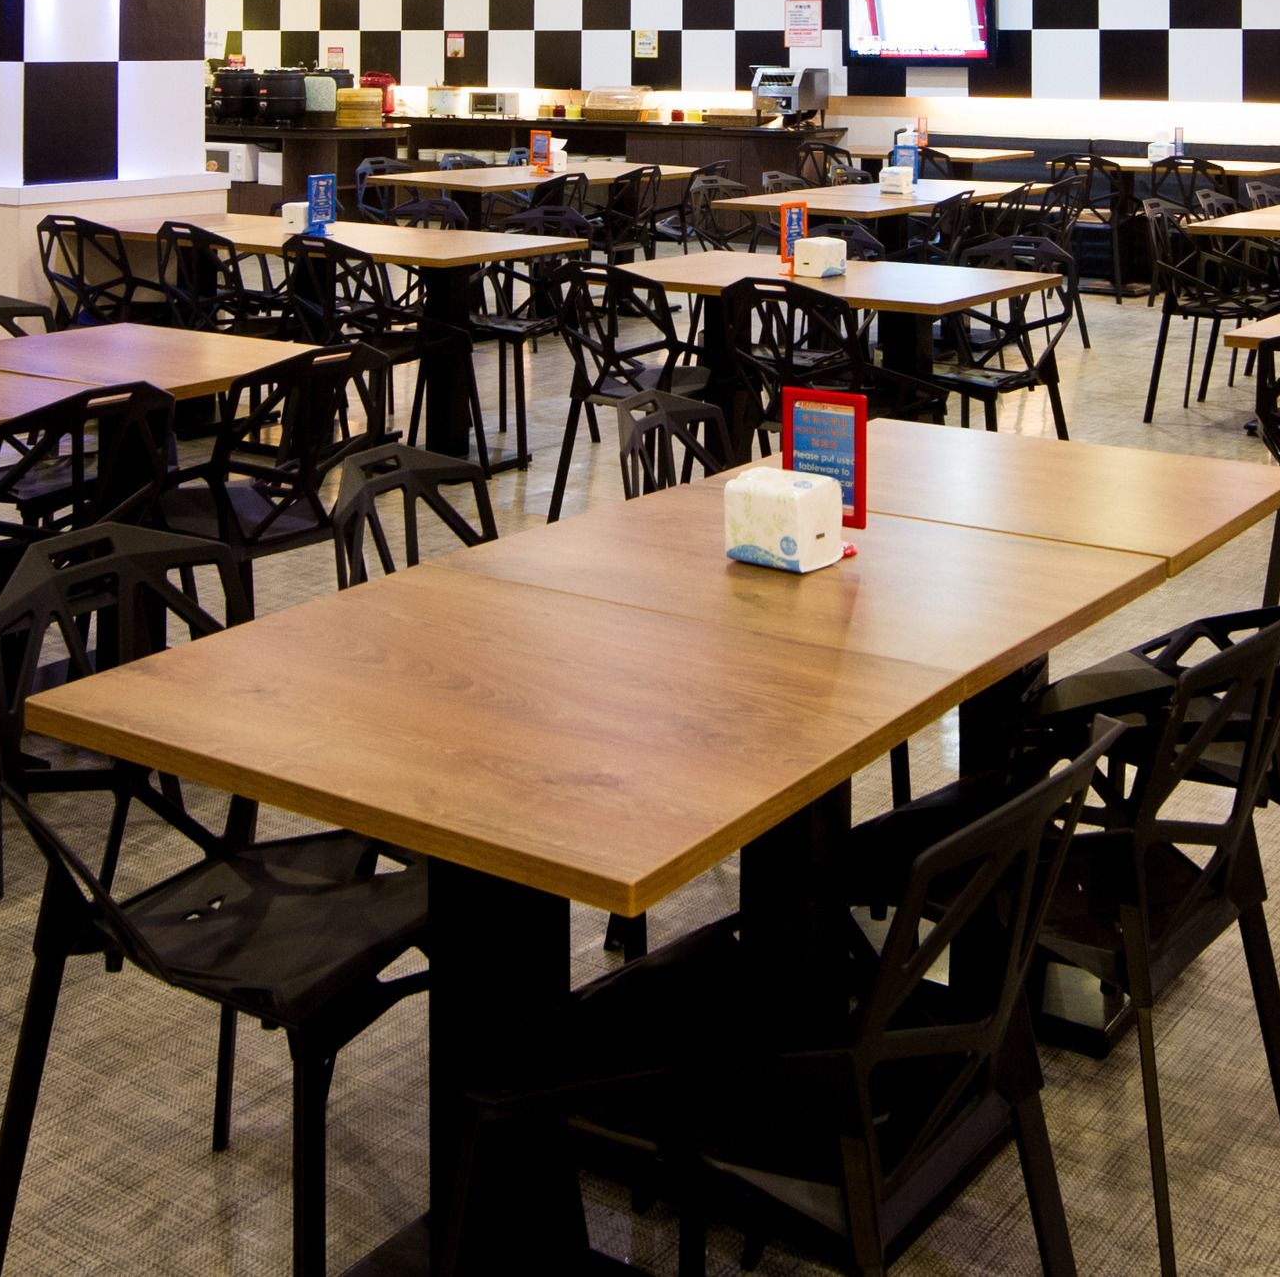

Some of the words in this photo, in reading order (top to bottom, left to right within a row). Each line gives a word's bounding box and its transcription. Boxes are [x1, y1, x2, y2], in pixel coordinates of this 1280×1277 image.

[821, 454, 835, 464] put
[799, 462, 840, 475] tableware
[842, 466, 850, 476] to
